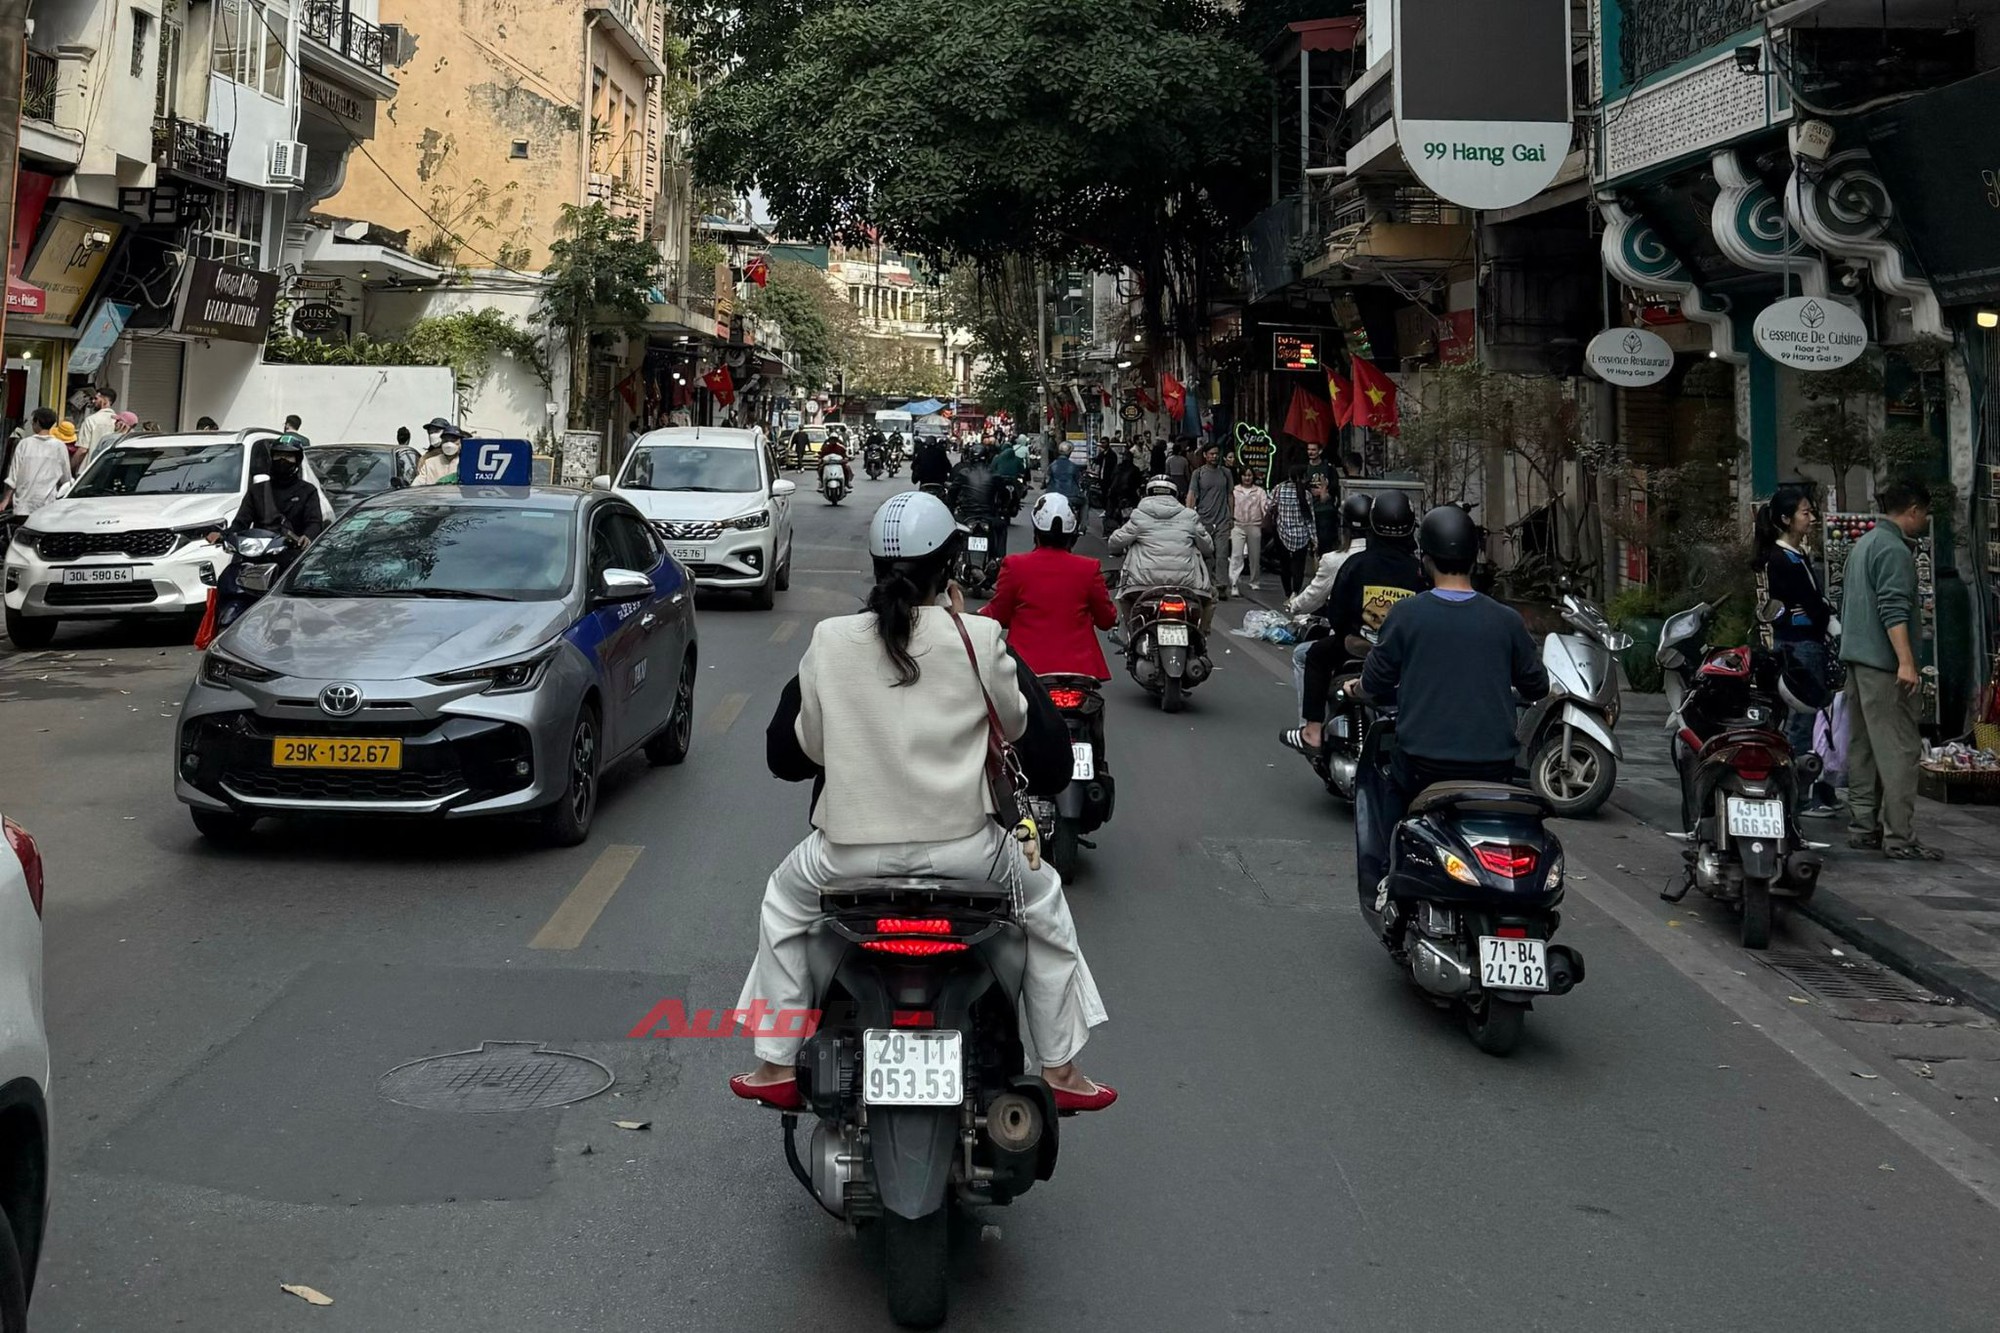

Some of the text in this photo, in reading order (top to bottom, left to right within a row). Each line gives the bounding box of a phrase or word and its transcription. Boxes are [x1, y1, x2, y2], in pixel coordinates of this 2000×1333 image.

[1424, 142, 1547, 166] 99 Hang Gai
[300, 308, 332, 318] DUSK
[1761, 327, 1863, 346] L'essence De Cuisine
[1781, 352, 1791, 360] 99
[1793, 353, 1815, 362] Hang
[1816, 354, 1832, 362] Gai
[1243, 433, 1265, 444] Spa
[477, 444, 512, 480] G7
[284, 743, 390, 763] 29K-132.67
[1733, 817, 1780, 835] 166.56
[1490, 941, 1537, 964] 71-B4
[1485, 964, 1545, 987] 247.82
[870, 1068, 957, 1100] 953.53
